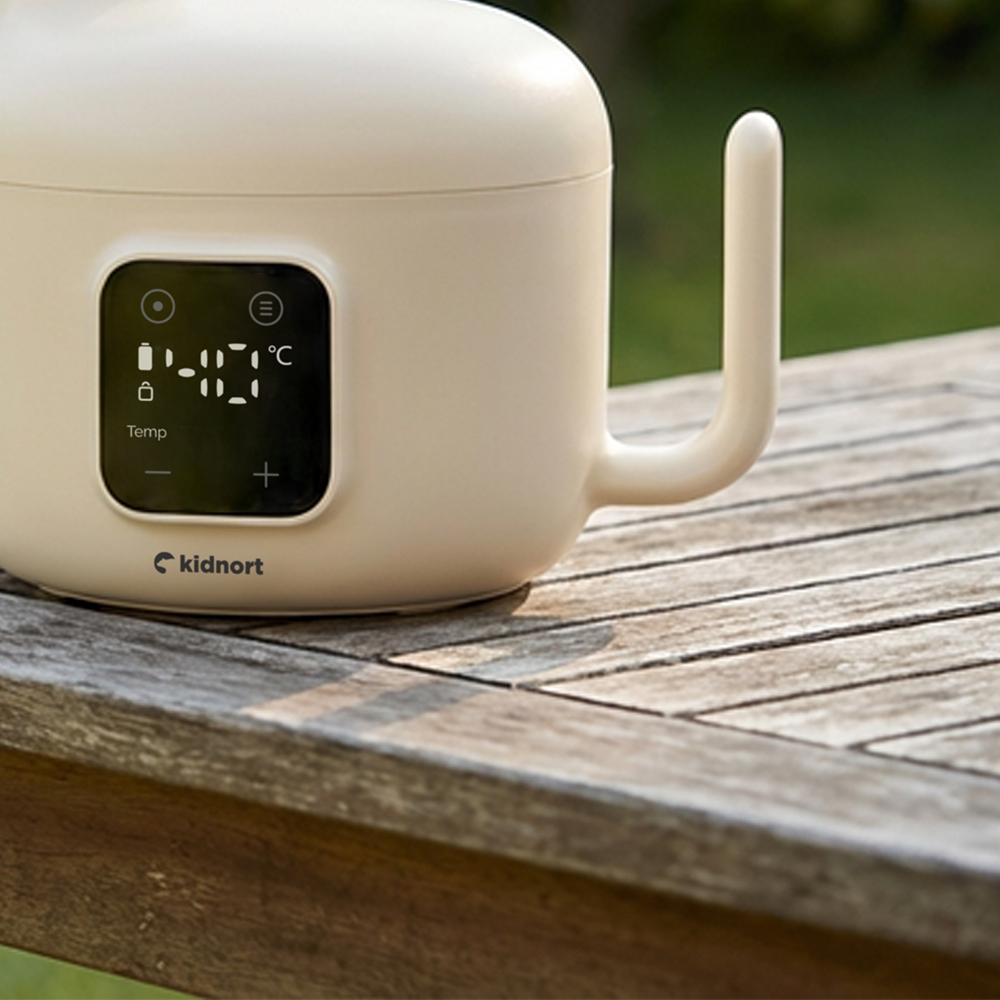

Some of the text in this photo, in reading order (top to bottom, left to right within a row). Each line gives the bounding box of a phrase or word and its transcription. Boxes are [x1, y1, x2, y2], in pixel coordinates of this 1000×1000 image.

[268, 344, 293, 367] °C
[126, 424, 168, 442] Temp
[179, 554, 264, 576] kidnort
